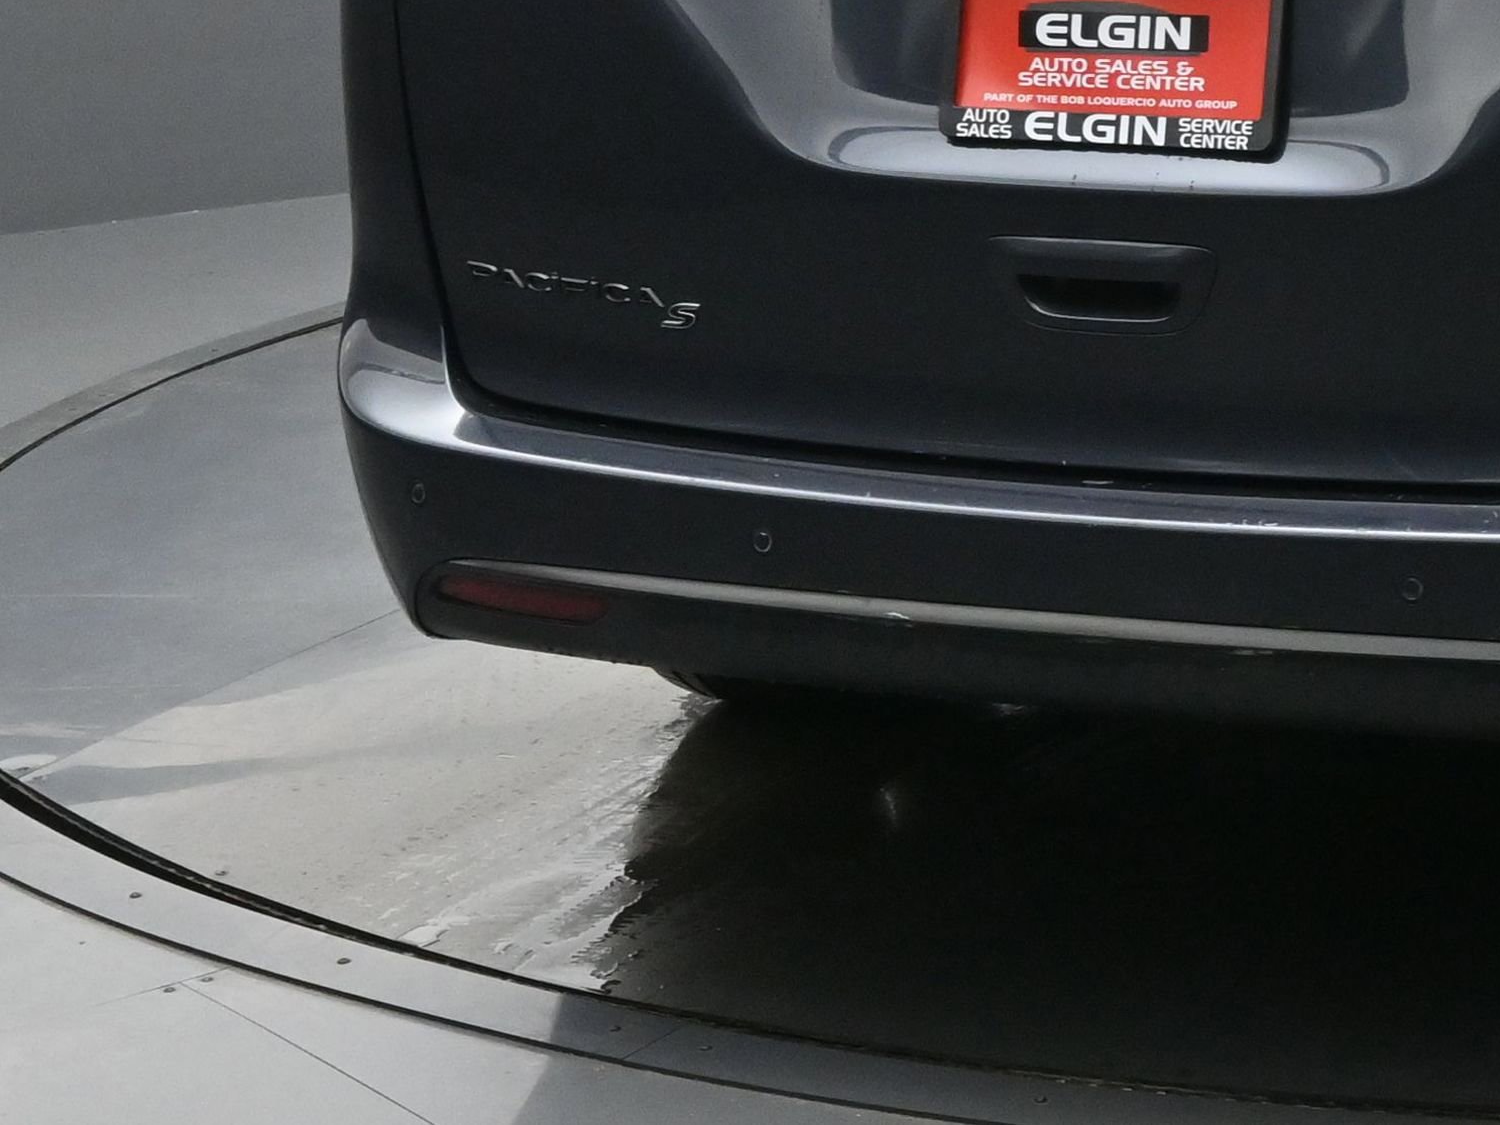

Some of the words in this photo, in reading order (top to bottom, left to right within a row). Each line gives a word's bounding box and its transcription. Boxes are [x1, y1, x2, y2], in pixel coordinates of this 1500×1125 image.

[1035, 13, 1191, 50] ELGIN
[1029, 57, 1088, 73] AUTO
[1095, 59, 1168, 75] SALES
[1176, 61, 1194, 76] &
[1018, 72, 1109, 88] SERVICE
[1116, 76, 1205, 92] CENTER
[984, 92, 1014, 102] PART
[1016, 94, 1034, 103] OF
[1036, 95, 1060, 104] THE
[1061, 95, 1085, 105] BOB
[1087, 96, 1156, 107] LOQUERCIO
[1159, 99, 1193, 108] AUTO
[1195, 99, 1238, 110] GROUP
[962, 108, 1010, 123] AUTO
[956, 123, 1012, 139] SALES
[1024, 111, 1167, 146] ELGIN
[1178, 118, 1253, 135] SERVICE
[1180, 133, 1249, 151] CENTER
[661, 302, 701, 330] S
